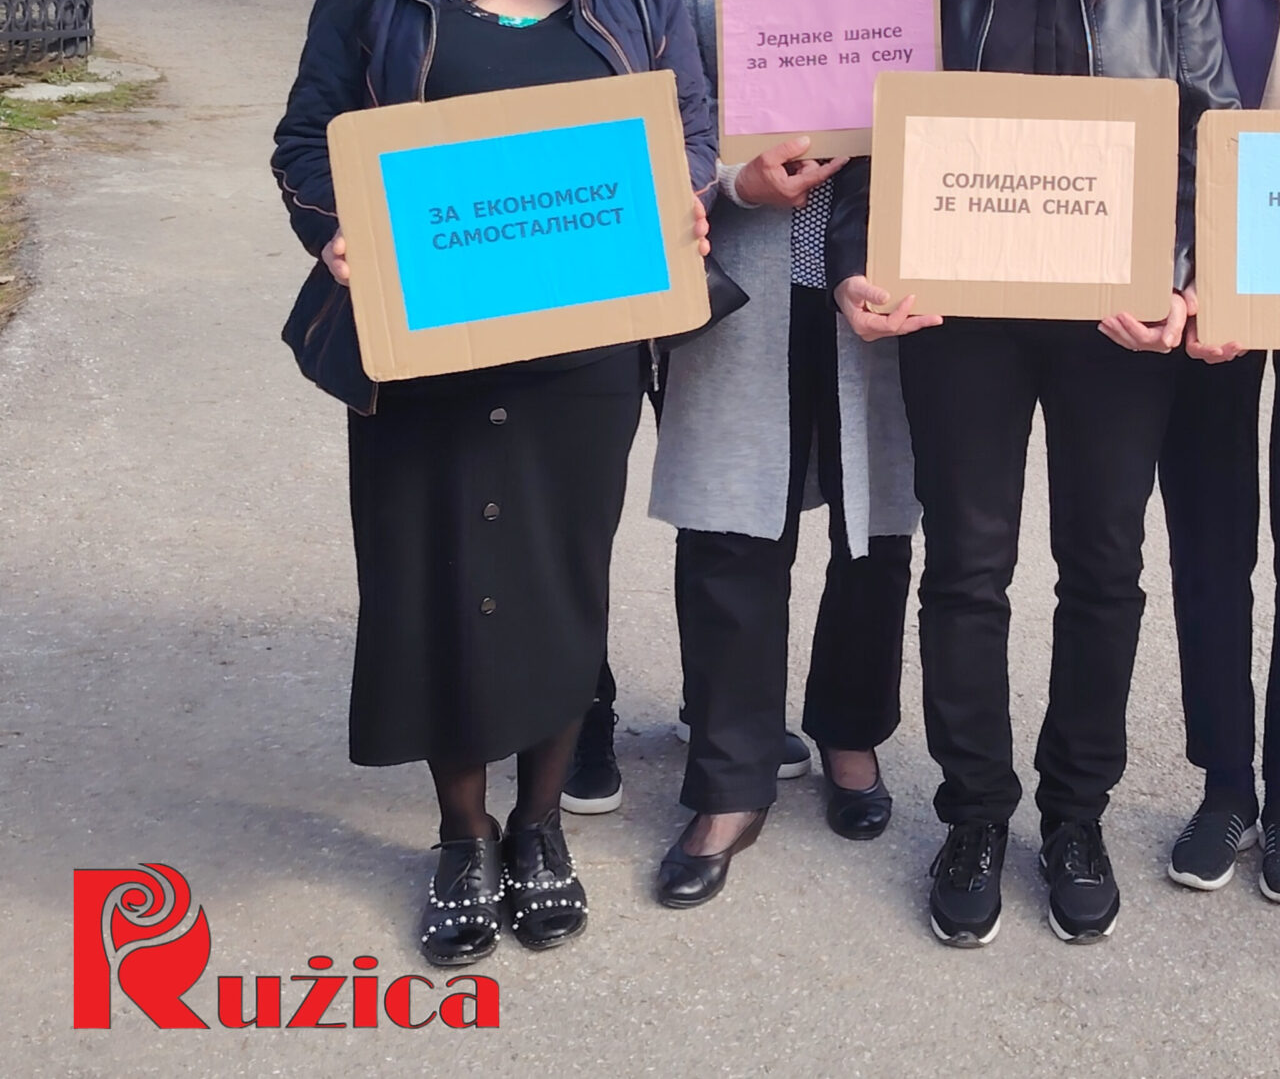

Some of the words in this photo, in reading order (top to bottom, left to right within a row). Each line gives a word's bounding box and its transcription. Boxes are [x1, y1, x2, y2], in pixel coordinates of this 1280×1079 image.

[757, 30, 833, 48] Једнаке
[844, 26, 903, 41] шансе
[746, 56, 768, 70] за
[778, 53, 828, 68] жене
[839, 51, 861, 65] на
[871, 47, 913, 63] селу
[942, 172, 1097, 193] СОЛИДАРНОСТ
[428, 205, 460, 225] ЗА
[473, 182, 619, 219] ЕКОНОМСКУ
[933, 196, 956, 212] ЈЕ
[968, 197, 1031, 214] НАША
[1042, 199, 1108, 216] СНАГА
[432, 207, 624, 251] САМОСТАЛНОСТ
